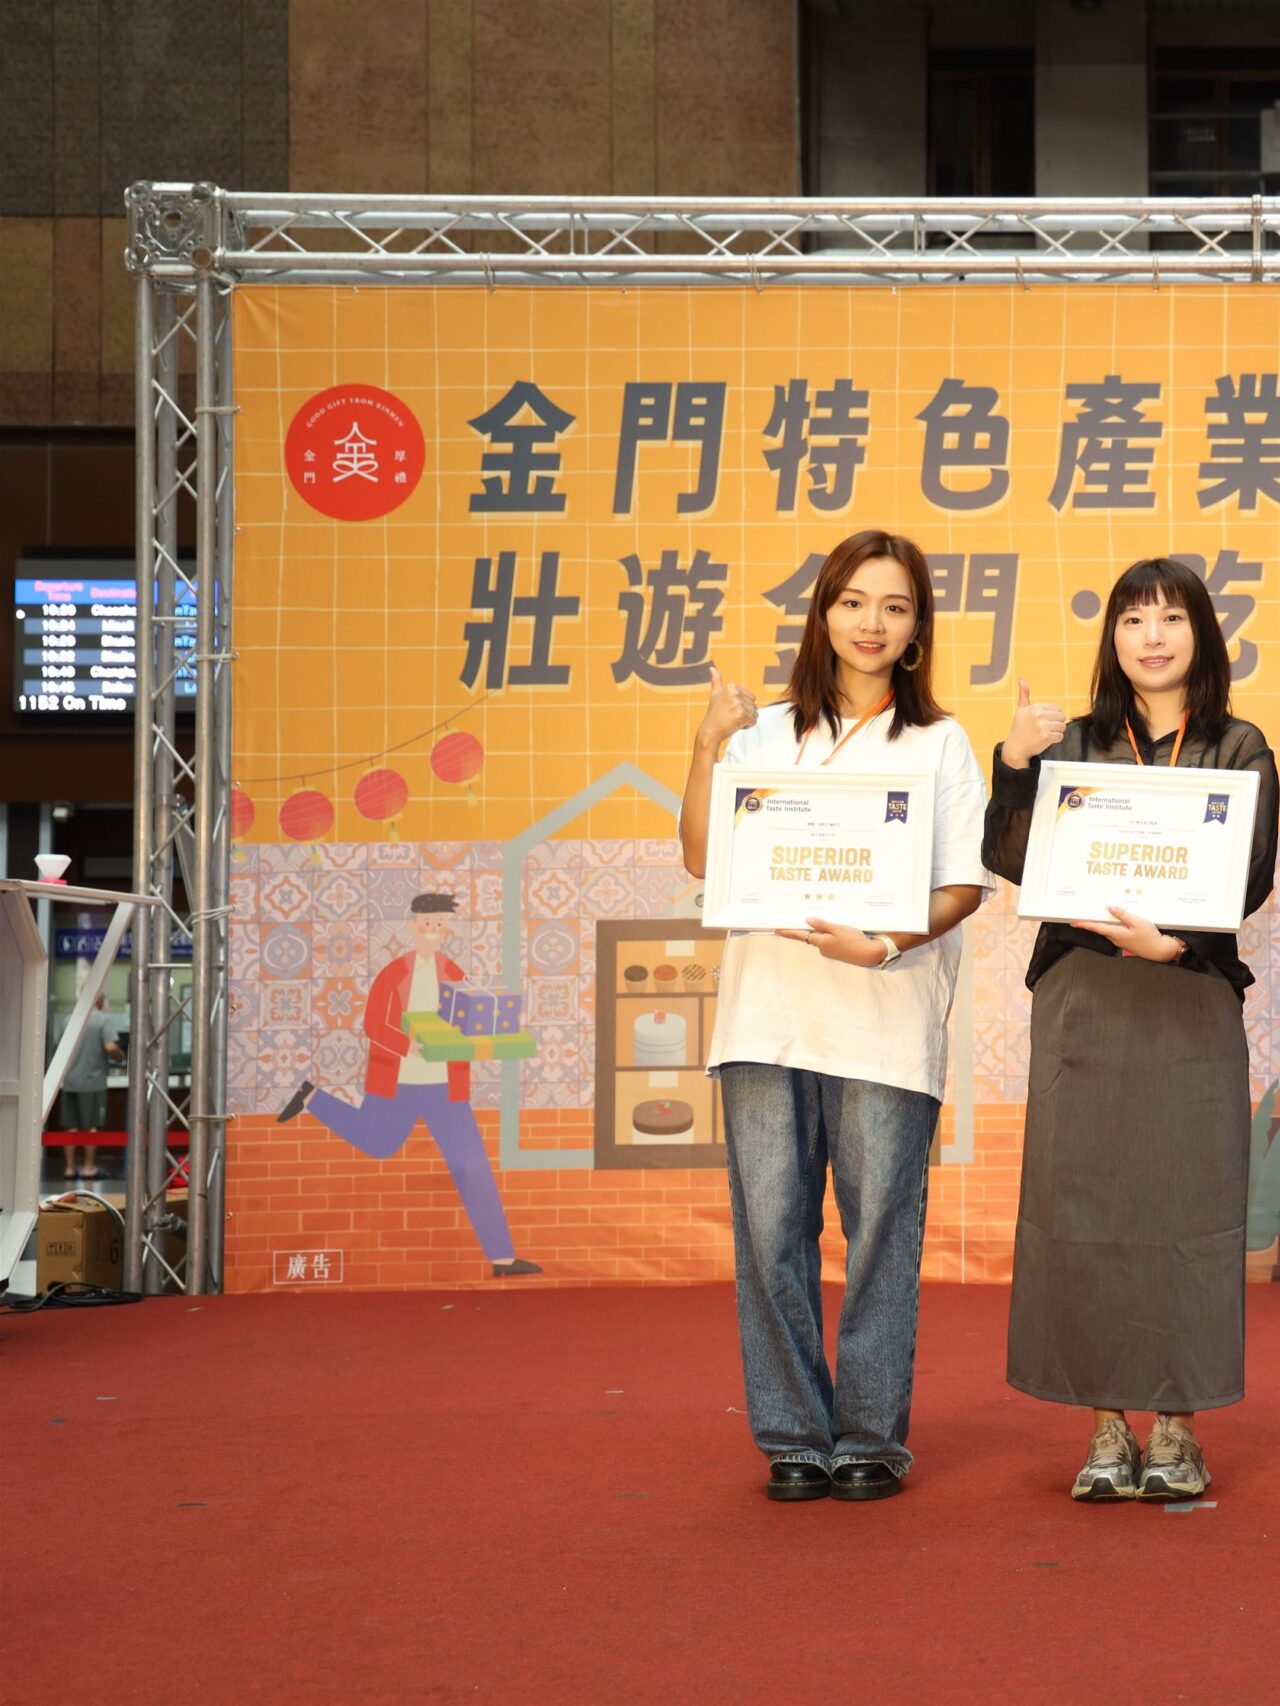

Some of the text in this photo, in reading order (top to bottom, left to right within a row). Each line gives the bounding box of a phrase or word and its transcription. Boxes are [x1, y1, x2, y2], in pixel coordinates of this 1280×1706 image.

[327, 398, 346, 410] GIFT
[349, 397, 374, 406] FROM
[304, 449, 316, 484] 金門
[62, 694, 86, 711] On
[88, 694, 127, 711] Time
[888, 803, 908, 811] TASTE
[1088, 802, 1133, 811] Taste Institute
[1089, 796, 1131, 804] International
[1208, 804, 1227, 812] TASTE
[771, 846, 872, 866] SUPERIOR
[1089, 841, 1189, 864] SUPERIOR
[769, 866, 874, 883] TASTE AWARD
[1086, 860, 1188, 880] TASTE AWARD
[286, 1254, 332, 1281] 廣告
